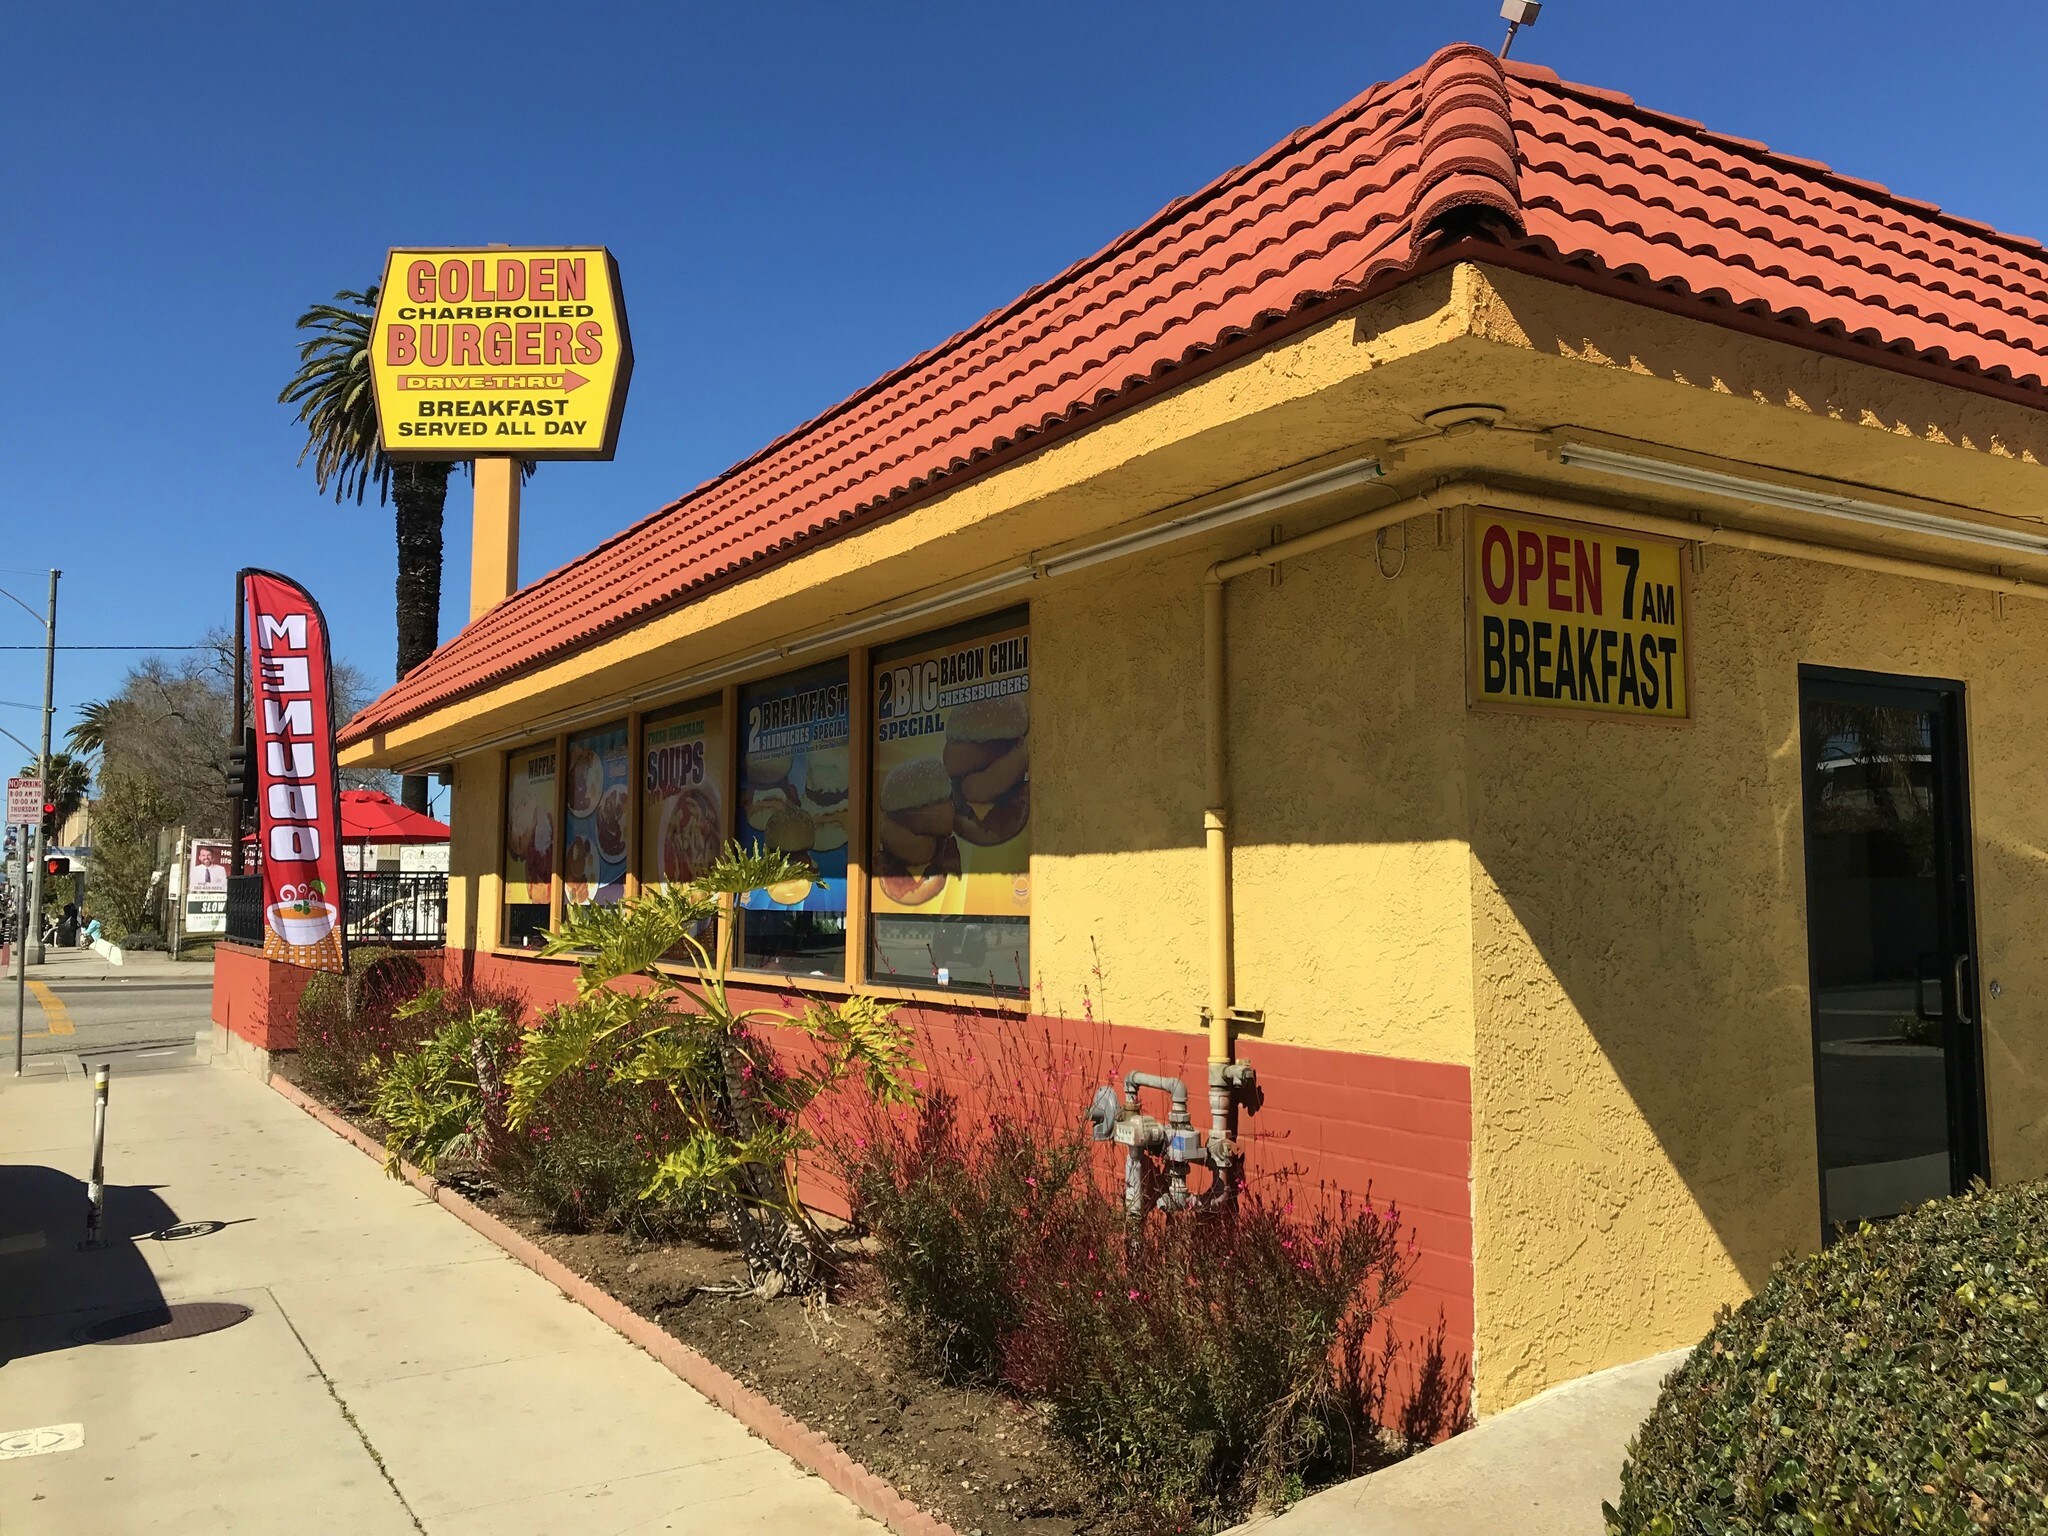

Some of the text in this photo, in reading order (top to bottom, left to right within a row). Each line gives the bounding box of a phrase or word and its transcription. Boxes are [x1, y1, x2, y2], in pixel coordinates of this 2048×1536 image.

[407, 258, 586, 304] GOLDEN
[398, 305, 594, 320] CHARBROILED
[387, 321, 603, 367] BURGERS
[406, 376, 564, 389] DRIVE-THRU
[418, 400, 569, 417] BREAKFAST
[398, 420, 587, 437] SERVED ALL DAY
[1481, 524, 1675, 625] OPEN 7 AM
[893, 660, 939, 719] BIG
[940, 647, 984, 687] BACON
[989, 635, 1029, 676] CHILI
[1483, 615, 1677, 709] BREAKFAST
[938, 674, 1030, 709] CHEESEBURGERS
[748, 706, 761, 753] 2
[762, 683, 849, 733] BREAKFAST
[878, 713, 945, 742] SPECIAL
[762, 727, 810, 751] SANDWICHES
[813, 719, 848, 743] SPECIAL
[647, 741, 705, 793] SOUPS
[9, 780, 42, 788] NO PARKING
[201, 902, 226, 913] SLOW
